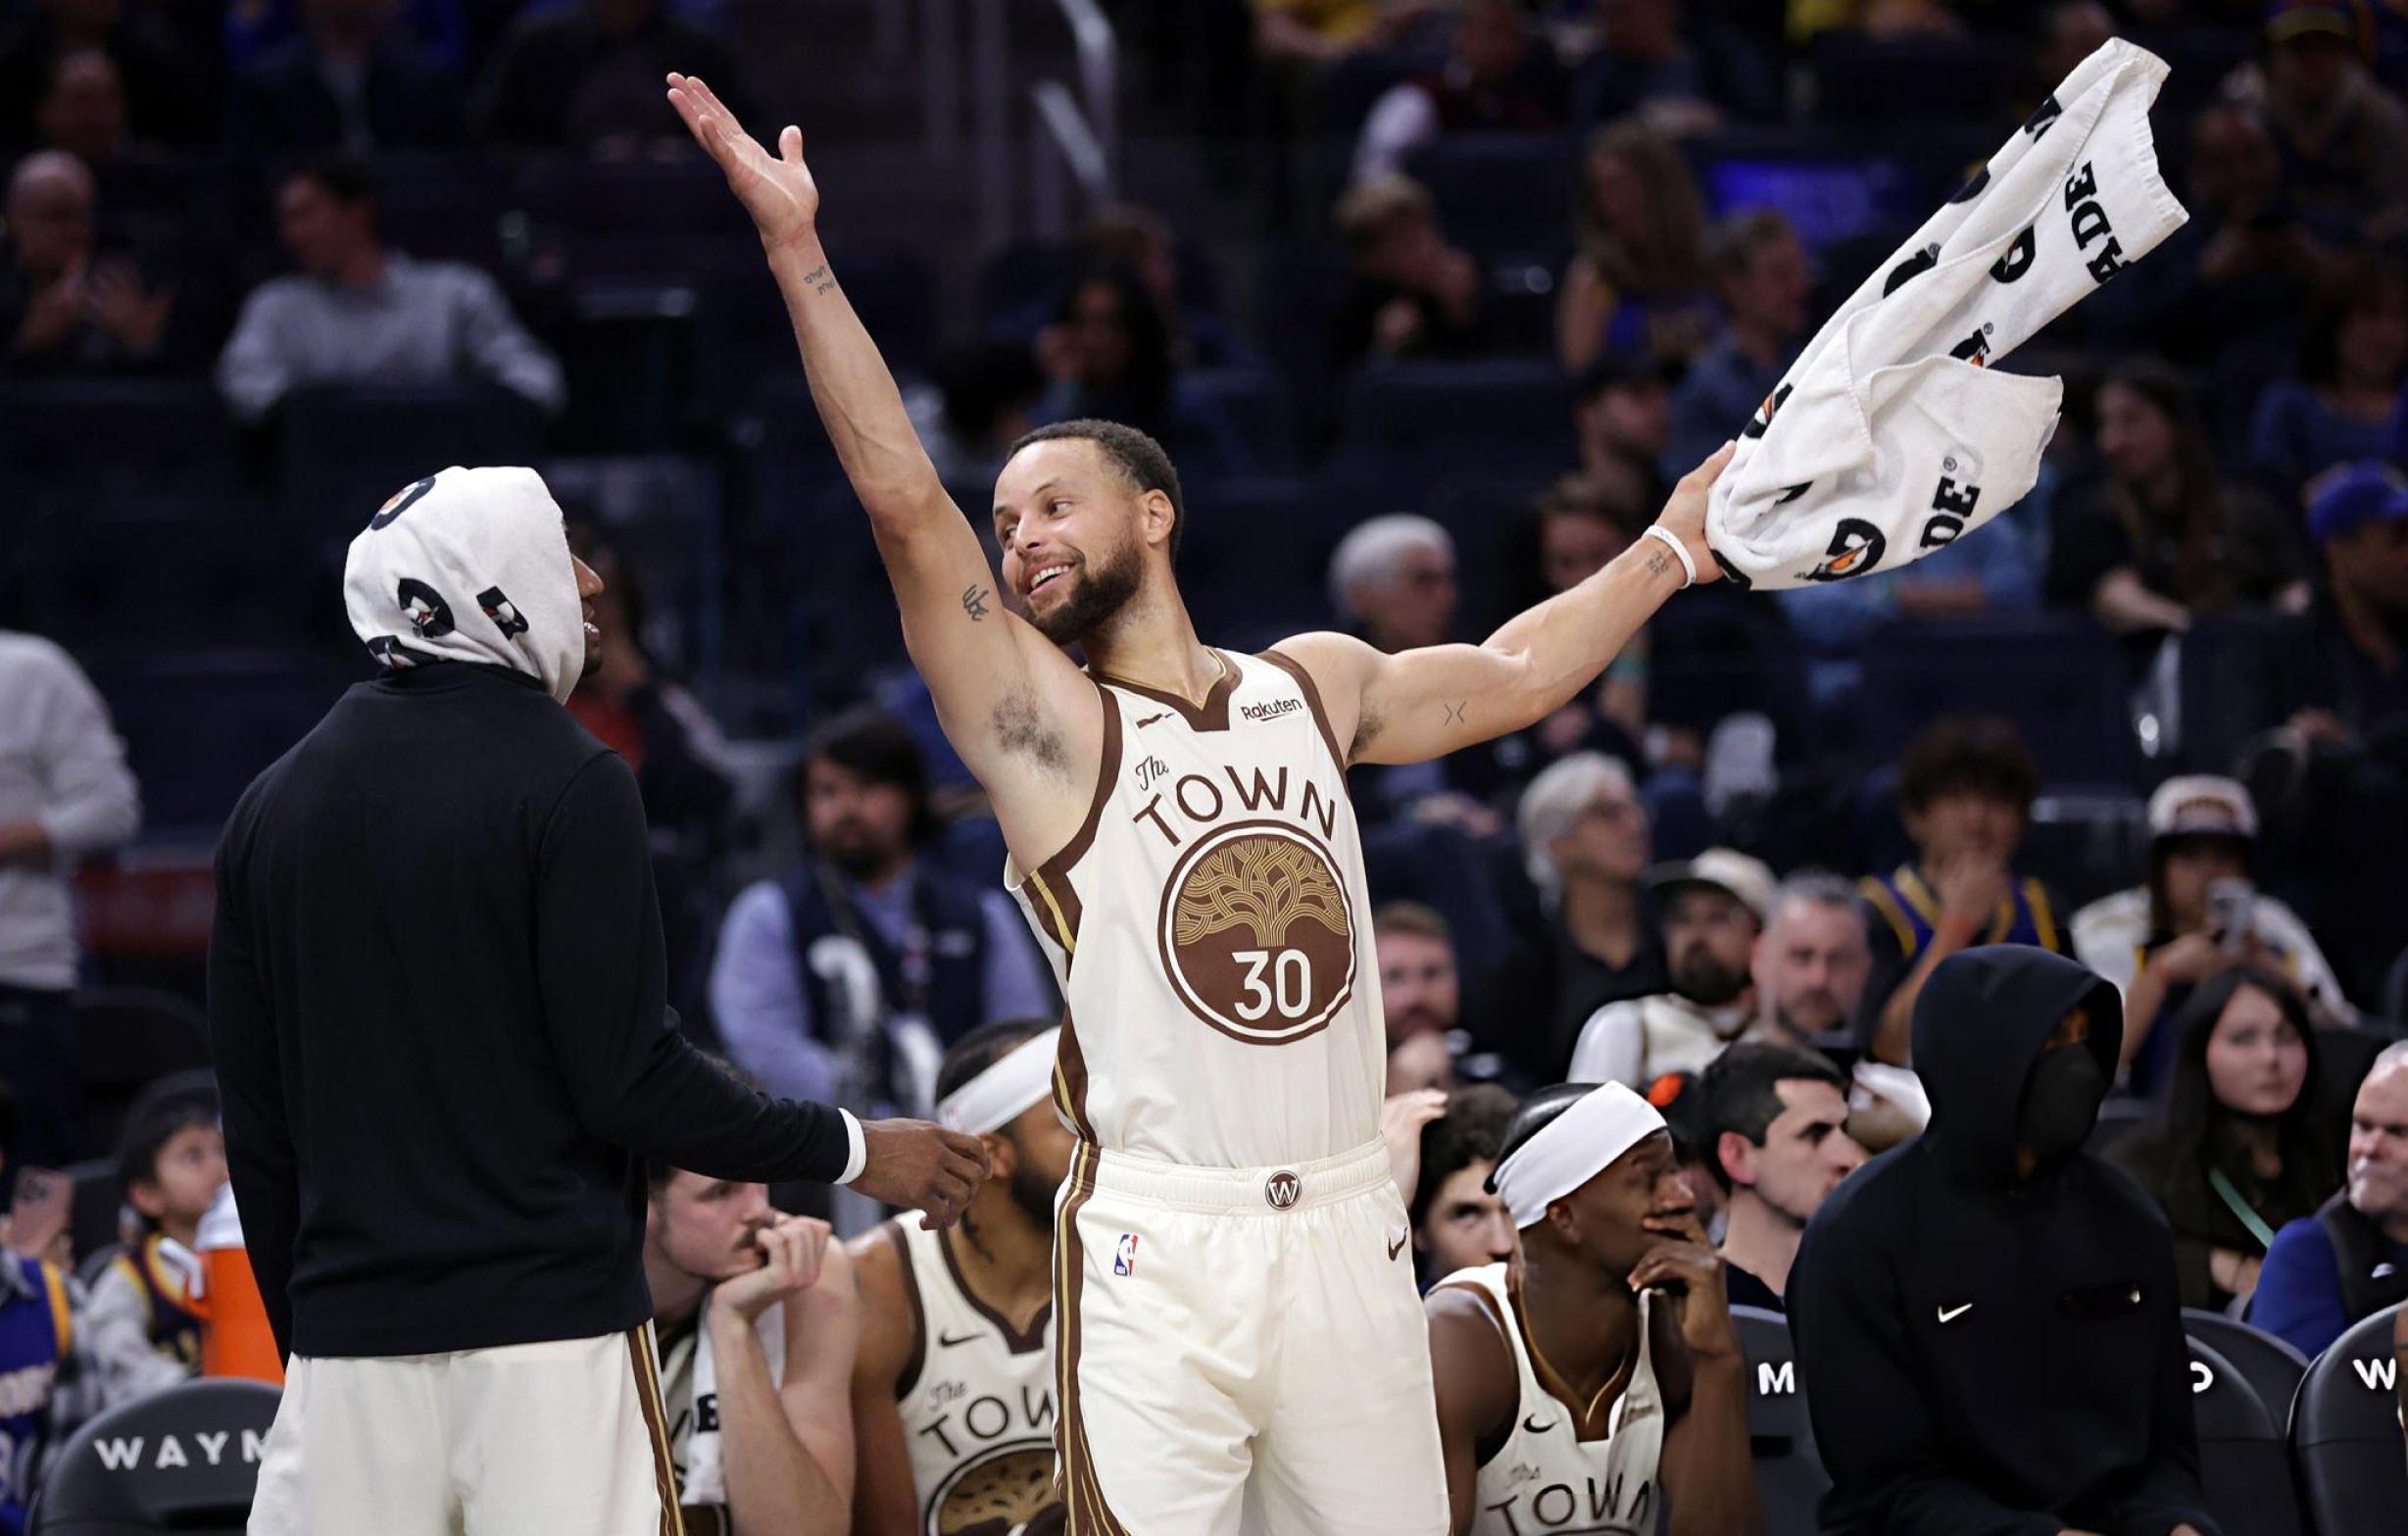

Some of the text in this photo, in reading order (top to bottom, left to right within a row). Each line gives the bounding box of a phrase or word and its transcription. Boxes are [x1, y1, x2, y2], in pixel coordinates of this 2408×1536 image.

[1240, 697, 1302, 721] Rakuten
[1133, 765, 1336, 848] TOWN
[1231, 948, 1311, 1021] 30
